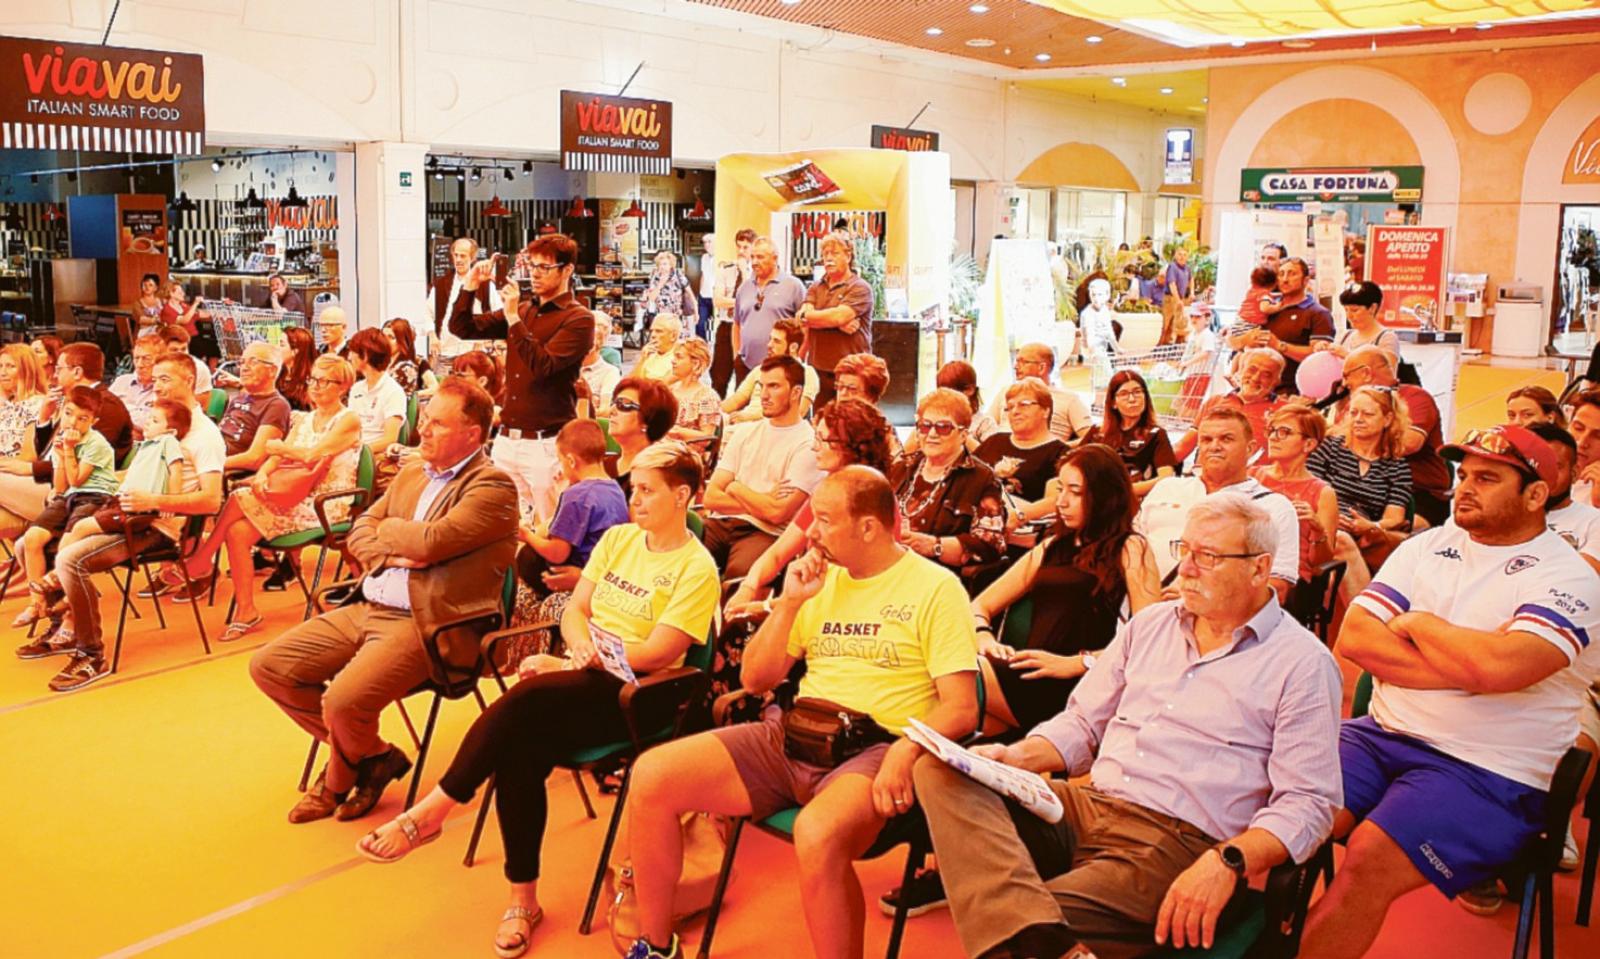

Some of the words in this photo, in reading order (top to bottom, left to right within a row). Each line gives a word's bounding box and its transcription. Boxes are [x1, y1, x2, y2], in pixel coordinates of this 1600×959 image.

[27, 99, 84, 115] ITALIAN
[88, 103, 135, 119] SMART
[139, 106, 180, 121] FOOD
[578, 135, 609, 147] ITALIAN
[610, 137, 636, 148] SMART
[636, 139, 660, 150] FOOD
[1269, 177, 1308, 190] CASA
[1313, 176, 1389, 190] FORTUNA
[1378, 230, 1439, 242] DOMENICA
[1385, 242, 1431, 253] APERTO
[603, 571, 650, 598] BASKET
[1548, 588, 1574, 600] PLAY
[821, 622, 882, 636] BASKET
